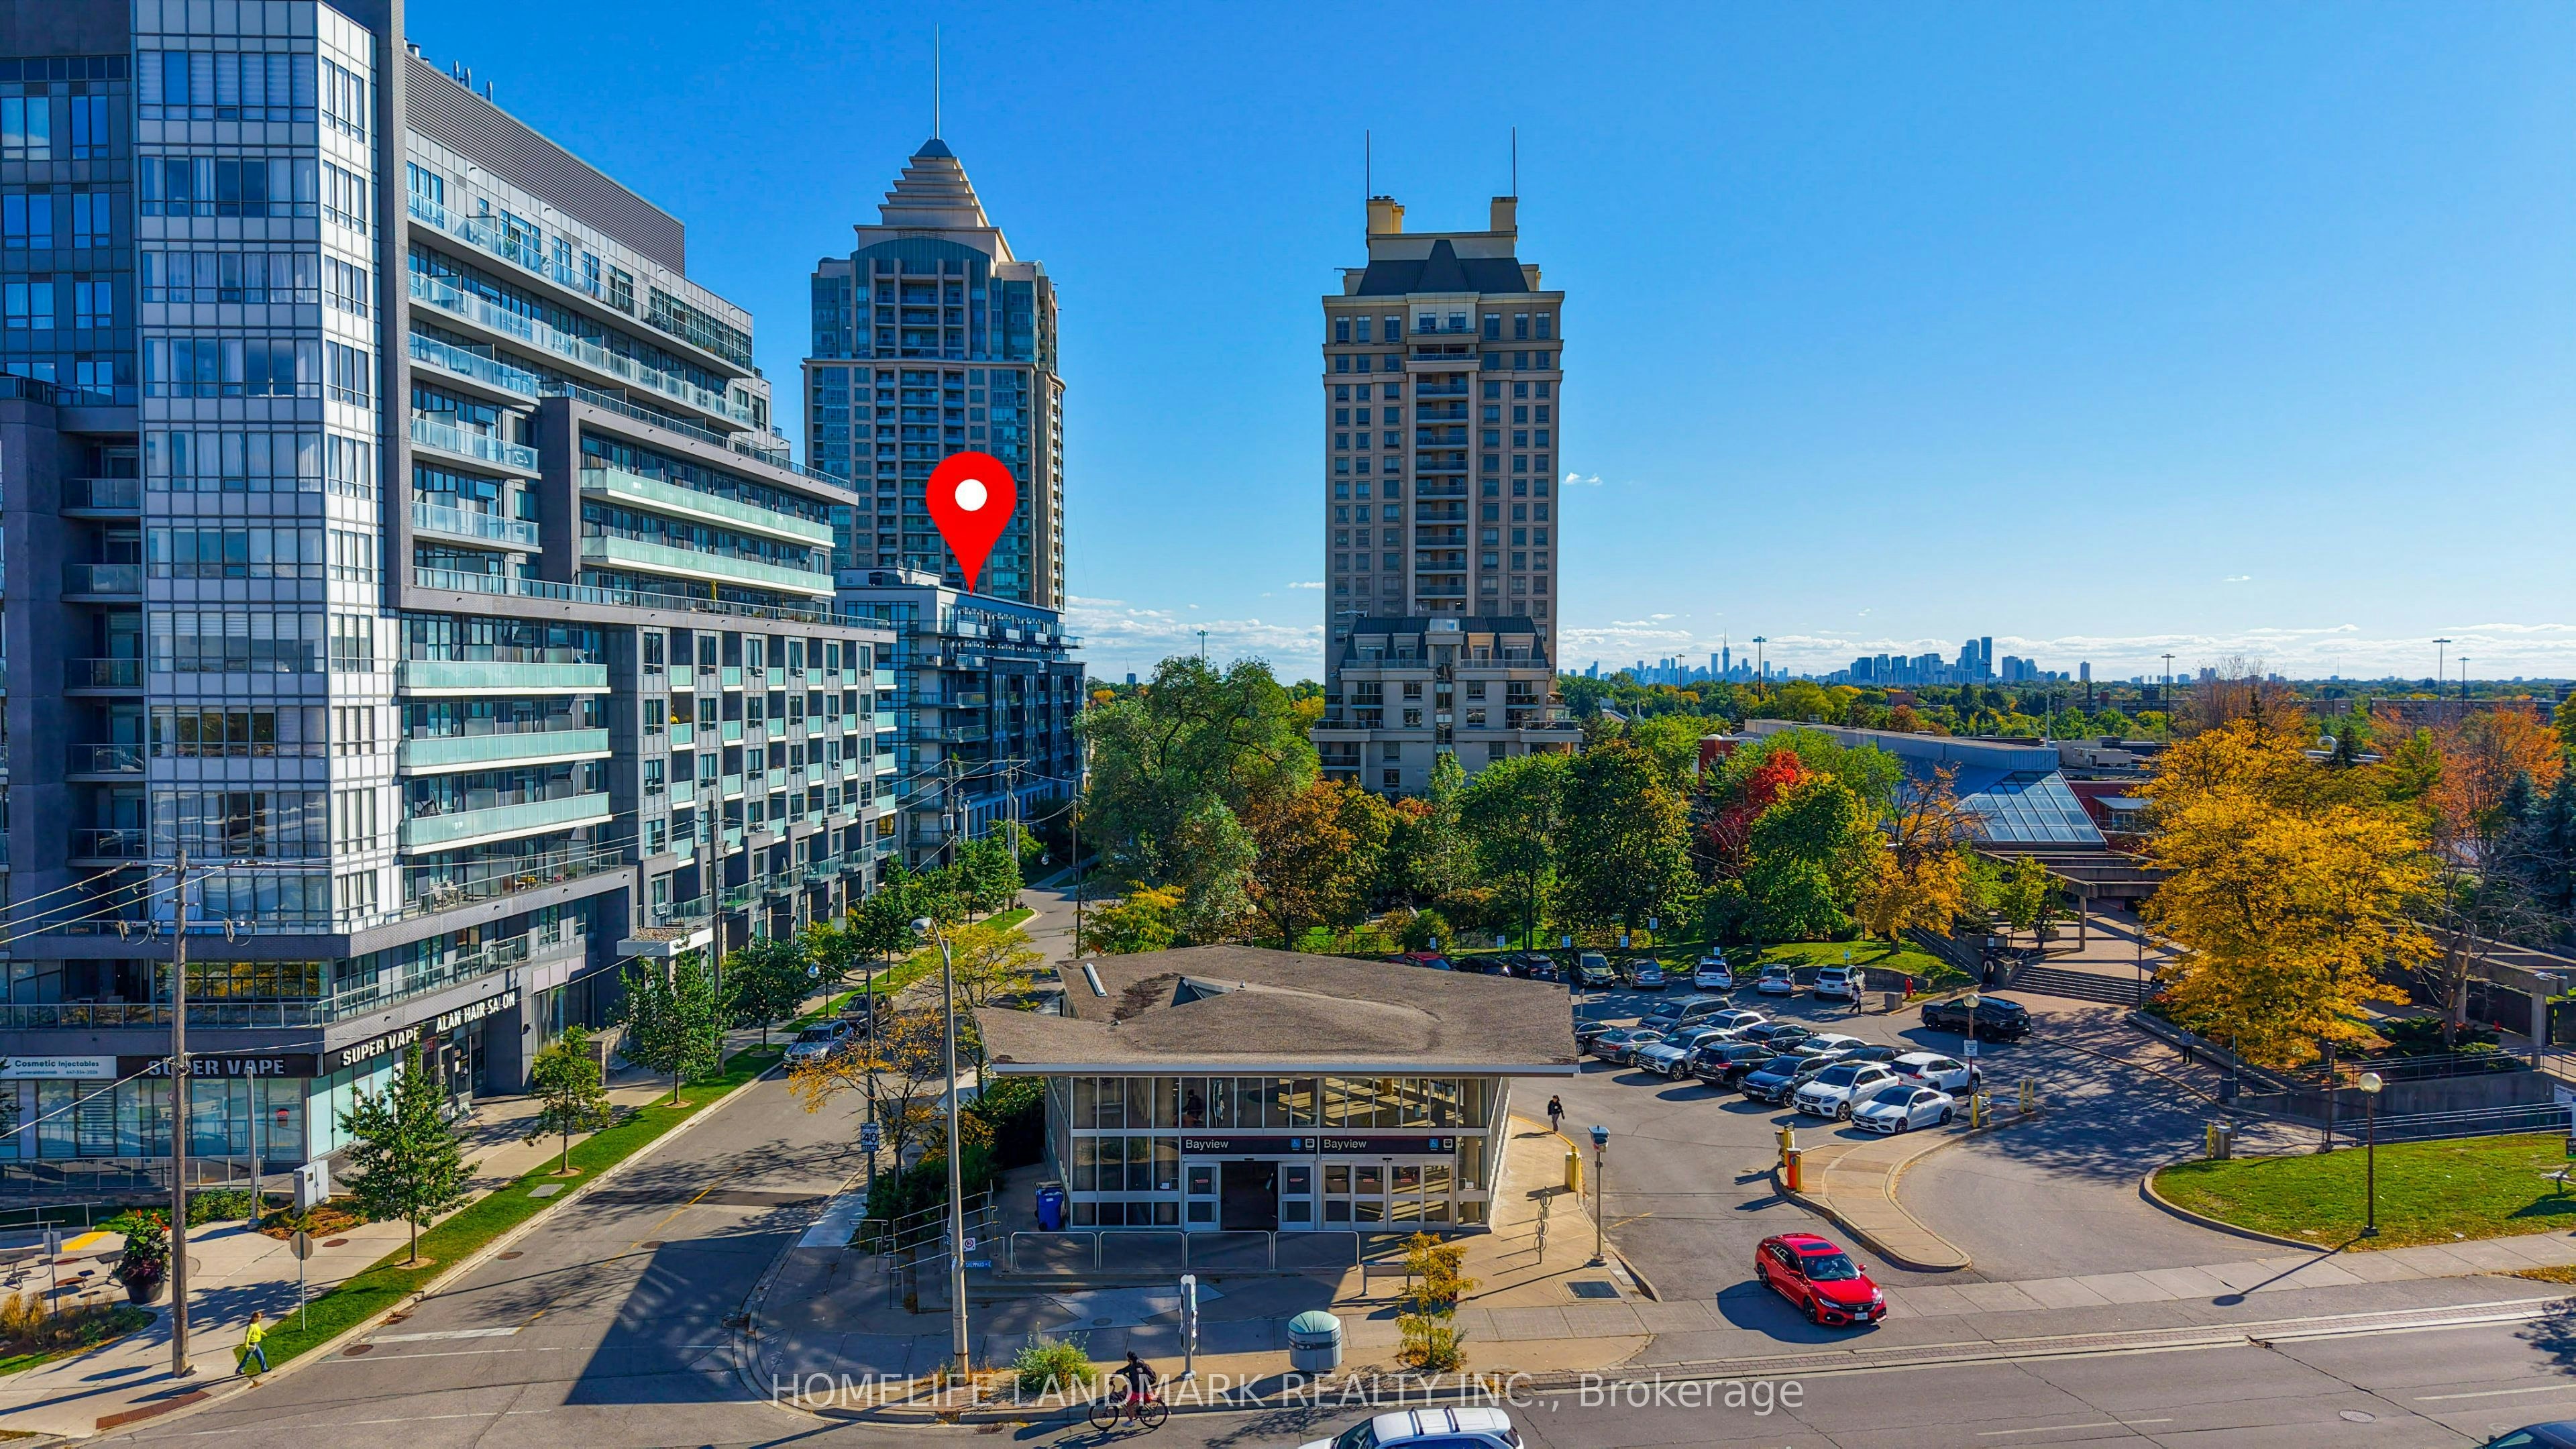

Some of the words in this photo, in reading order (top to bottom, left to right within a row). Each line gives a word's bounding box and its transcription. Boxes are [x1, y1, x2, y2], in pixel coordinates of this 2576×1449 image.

[436, 1010, 462, 1033] ALAN
[464, 1002, 486, 1023] HAIR
[487, 992, 515, 1015] SALON
[343, 1038, 385, 1066] SUPER
[388, 1026, 421, 1051] VAPE
[15, 1059, 56, 1067] Cosmetic
[58, 1060, 99, 1069] Injectables
[148, 1060, 220, 1075] SUER
[226, 1060, 284, 1075] VAPE
[862, 1132, 877, 1143] 40
[1185, 1139, 1229, 1151] Bayview
[1324, 1139, 1366, 1150] Bayview
